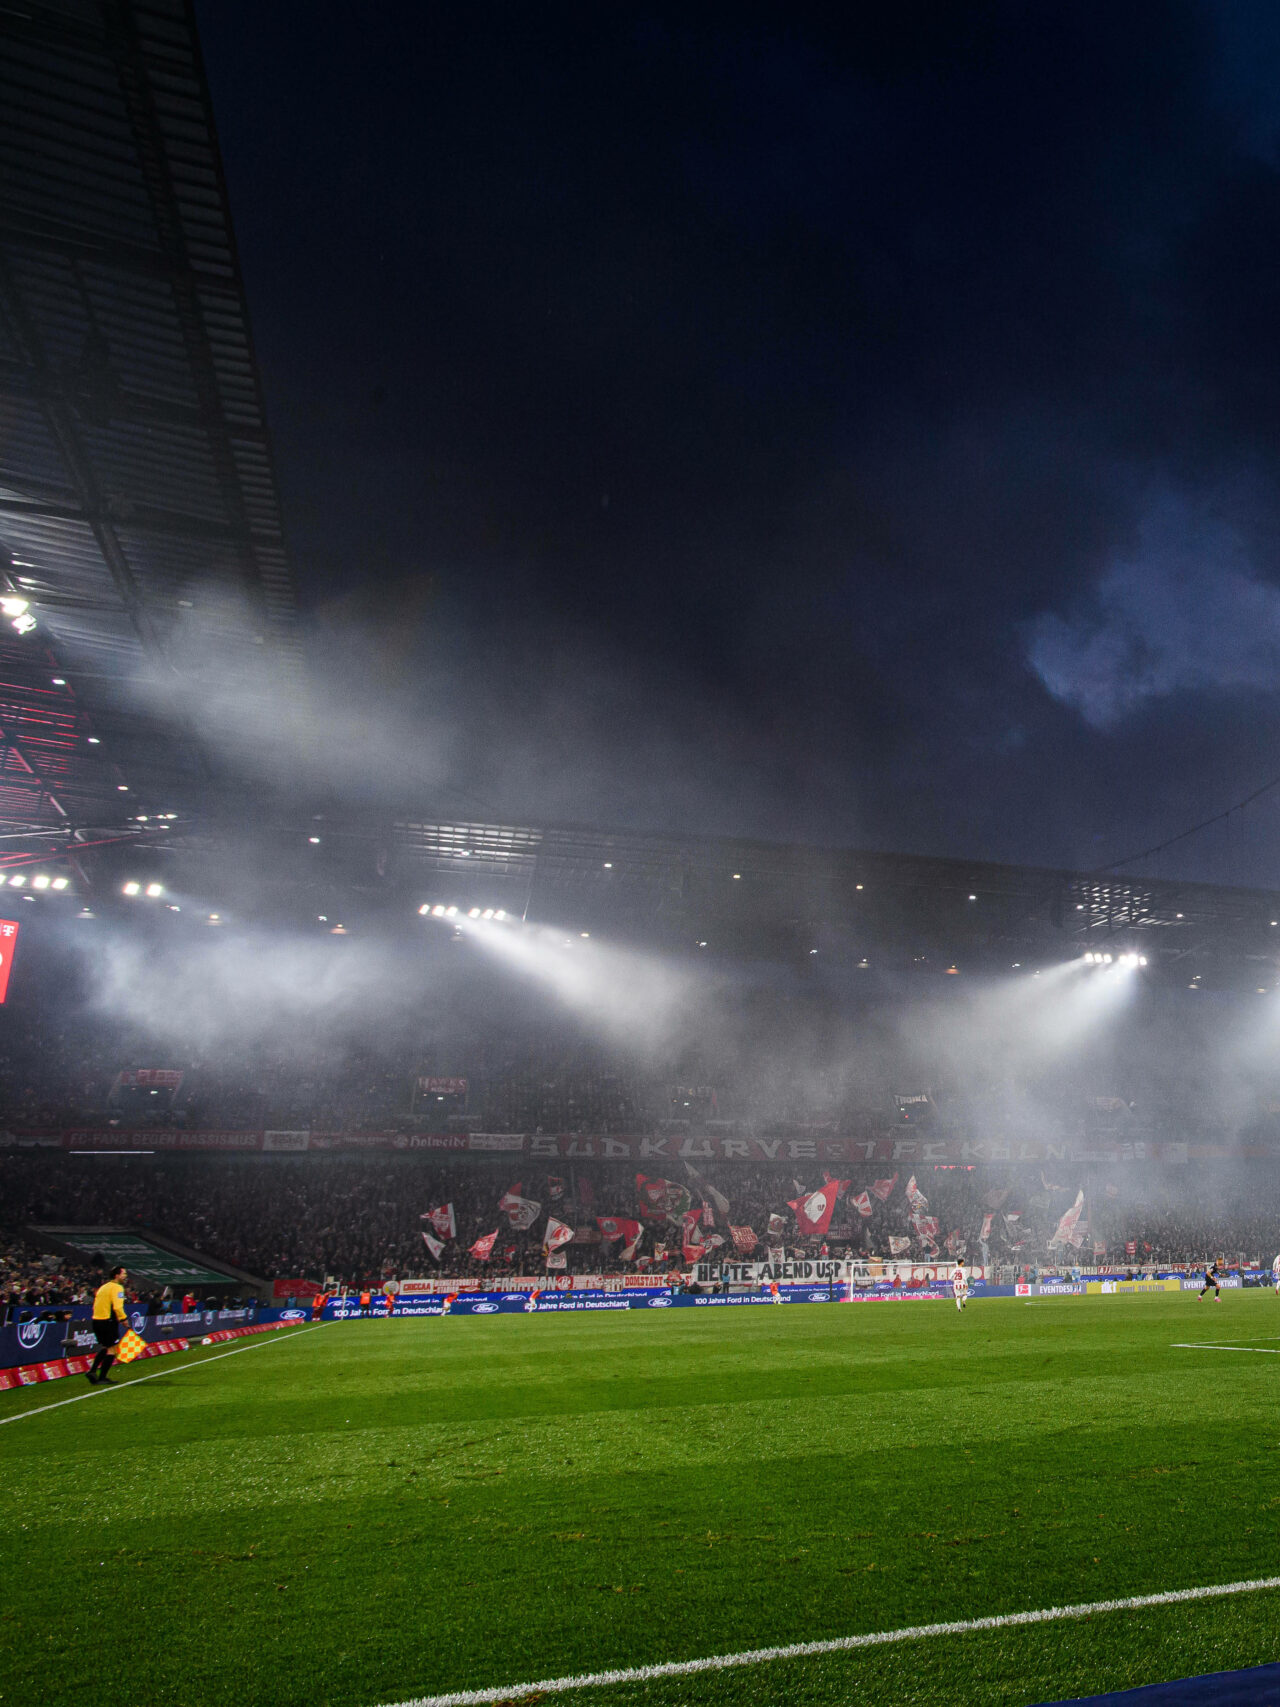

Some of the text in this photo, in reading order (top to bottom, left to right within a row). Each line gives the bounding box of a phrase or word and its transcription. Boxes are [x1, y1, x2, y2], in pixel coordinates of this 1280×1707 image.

[132, 1133, 177, 1146] GEGEN
[181, 1134, 258, 1146] RASSISMUS
[697, 1264, 753, 1282] HEUTE
[757, 1262, 814, 1281] ABEND
[815, 1261, 842, 1279] USP
[625, 1276, 664, 1287] DOMSTADT
[539, 1301, 558, 1310] Jahre
[559, 1301, 576, 1309] Ford
[586, 1299, 630, 1308] Deutschland
[695, 1297, 708, 1305] 100
[709, 1297, 727, 1305] Jahre
[334, 1309, 349, 1318] 100
